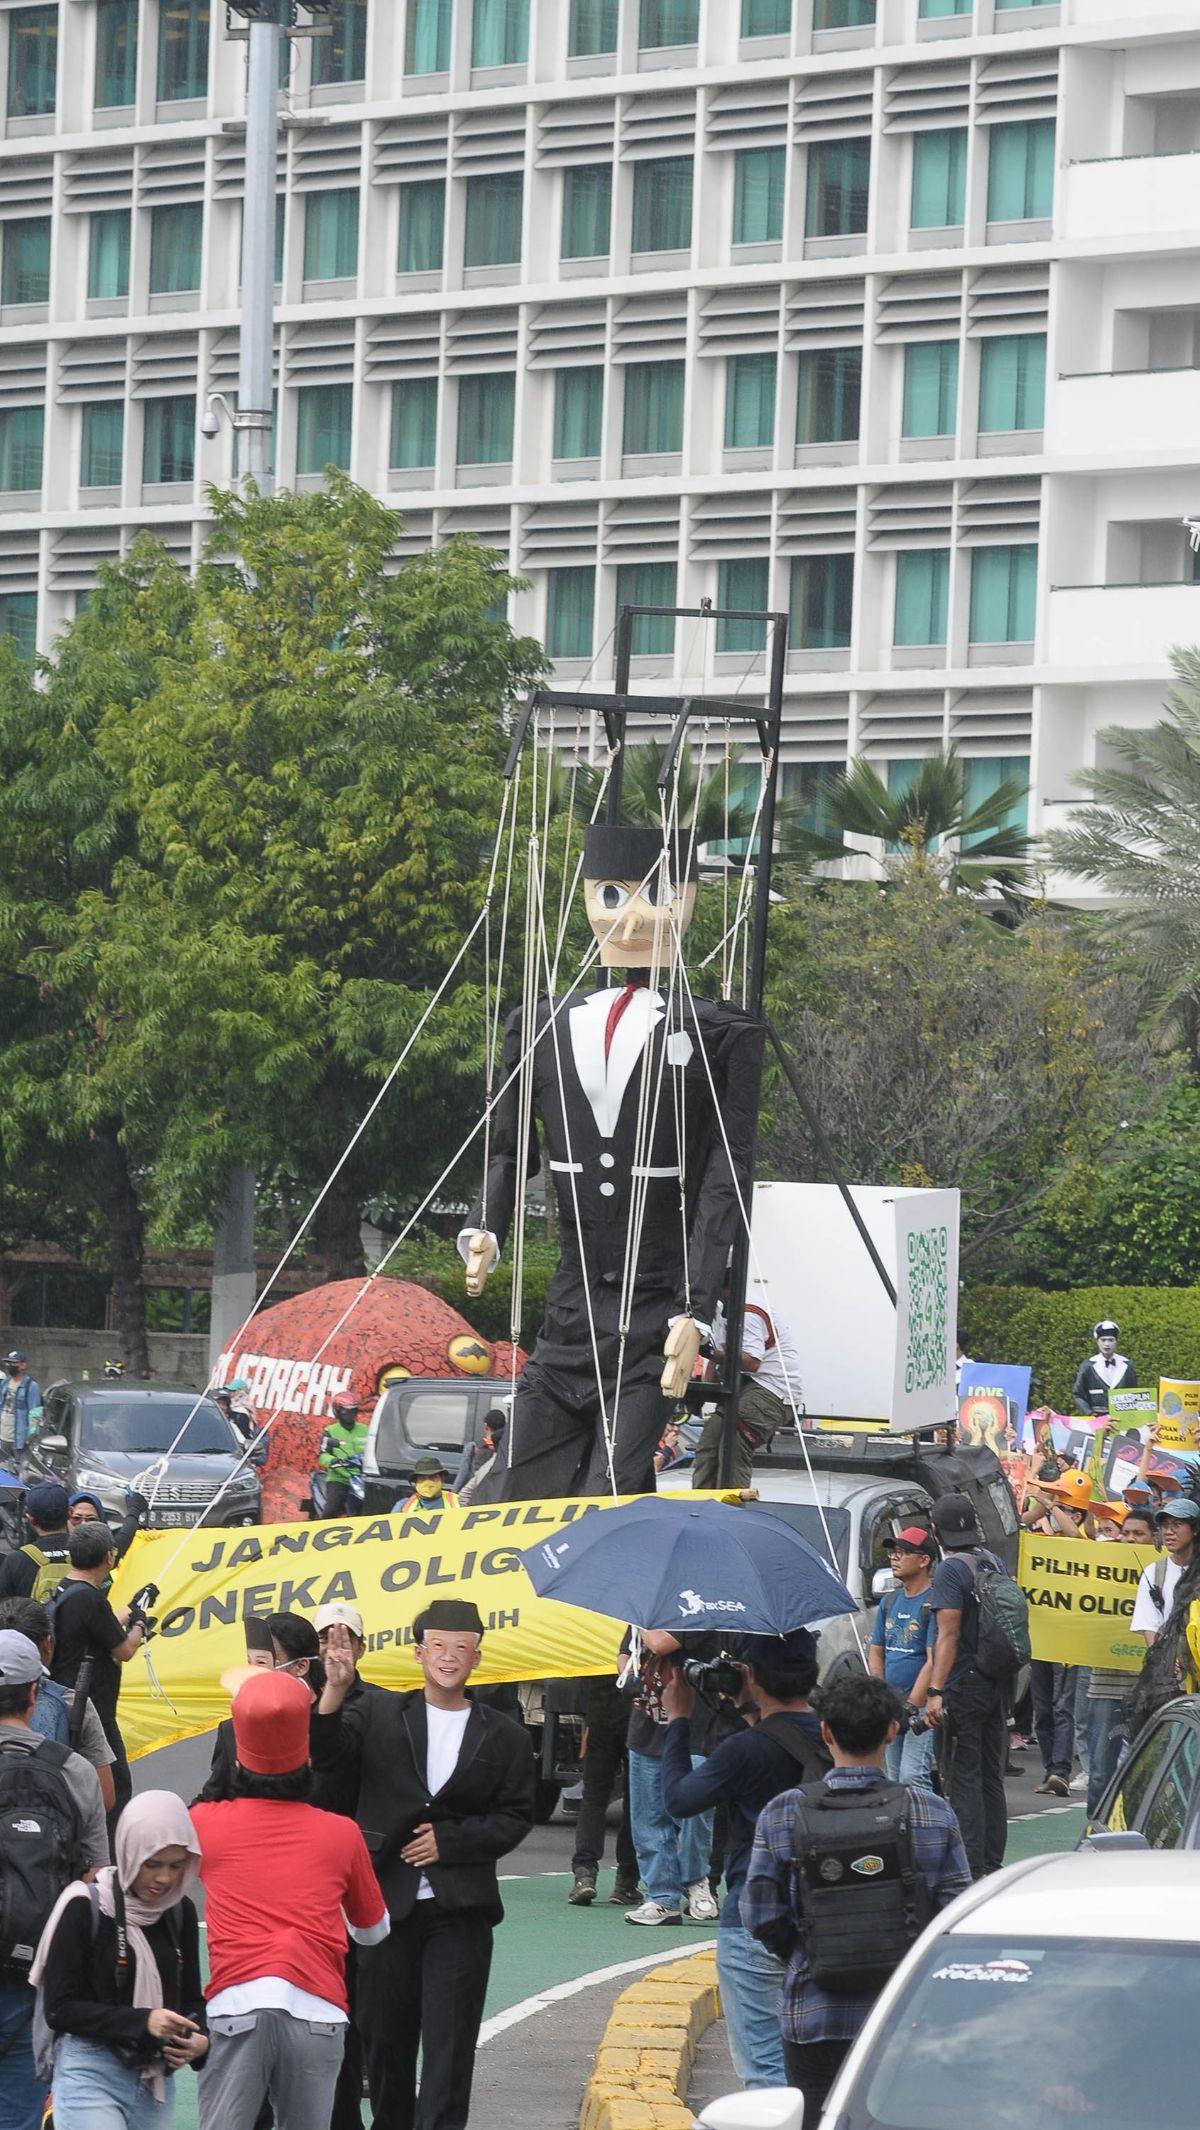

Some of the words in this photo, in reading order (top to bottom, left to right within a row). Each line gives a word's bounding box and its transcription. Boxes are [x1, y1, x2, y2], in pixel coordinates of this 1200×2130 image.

[149, 1511, 156, 1522] B
[191, 1514, 443, 1573] JANGAN
[461, 1504, 600, 1531] PILI
[380, 1547, 526, 1592] OLIG
[1031, 1556, 1089, 1578] PILIH
[1096, 1565, 1144, 1586] BUM
[1021, 1586, 1073, 1611] KAN
[1078, 1595, 1137, 1617] OLIG
[1110, 1643, 1148, 1657] GREE
[117, 1925, 126, 1958] SONY
